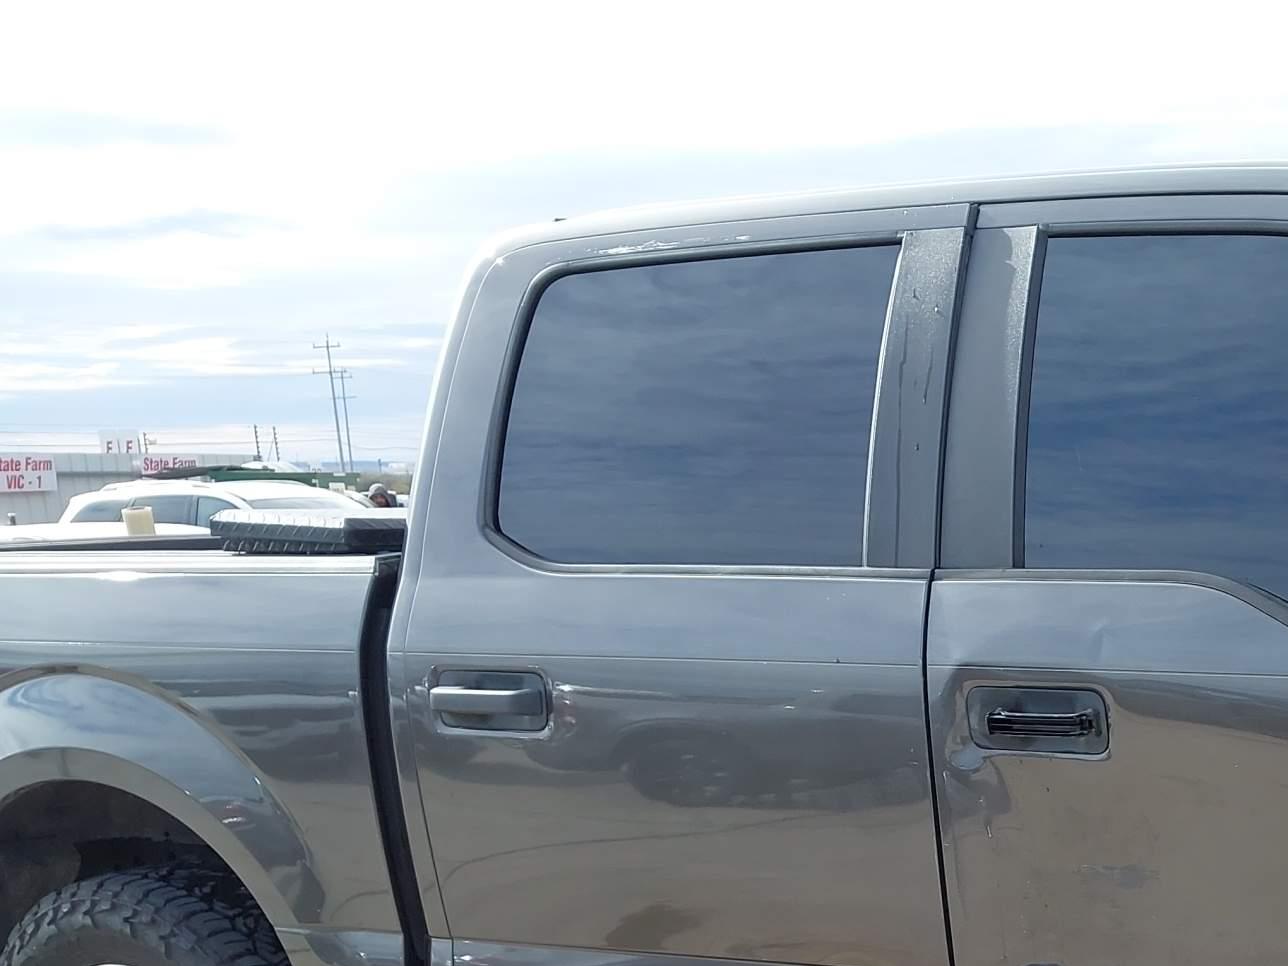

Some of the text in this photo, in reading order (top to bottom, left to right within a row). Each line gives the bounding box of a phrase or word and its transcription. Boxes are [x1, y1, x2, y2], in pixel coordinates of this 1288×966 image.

[25, 456, 52, 472] Farm
[143, 457, 197, 471] State Farm
[6, 474, 25, 489] VIC
[36, 475, 42, 489] 1
